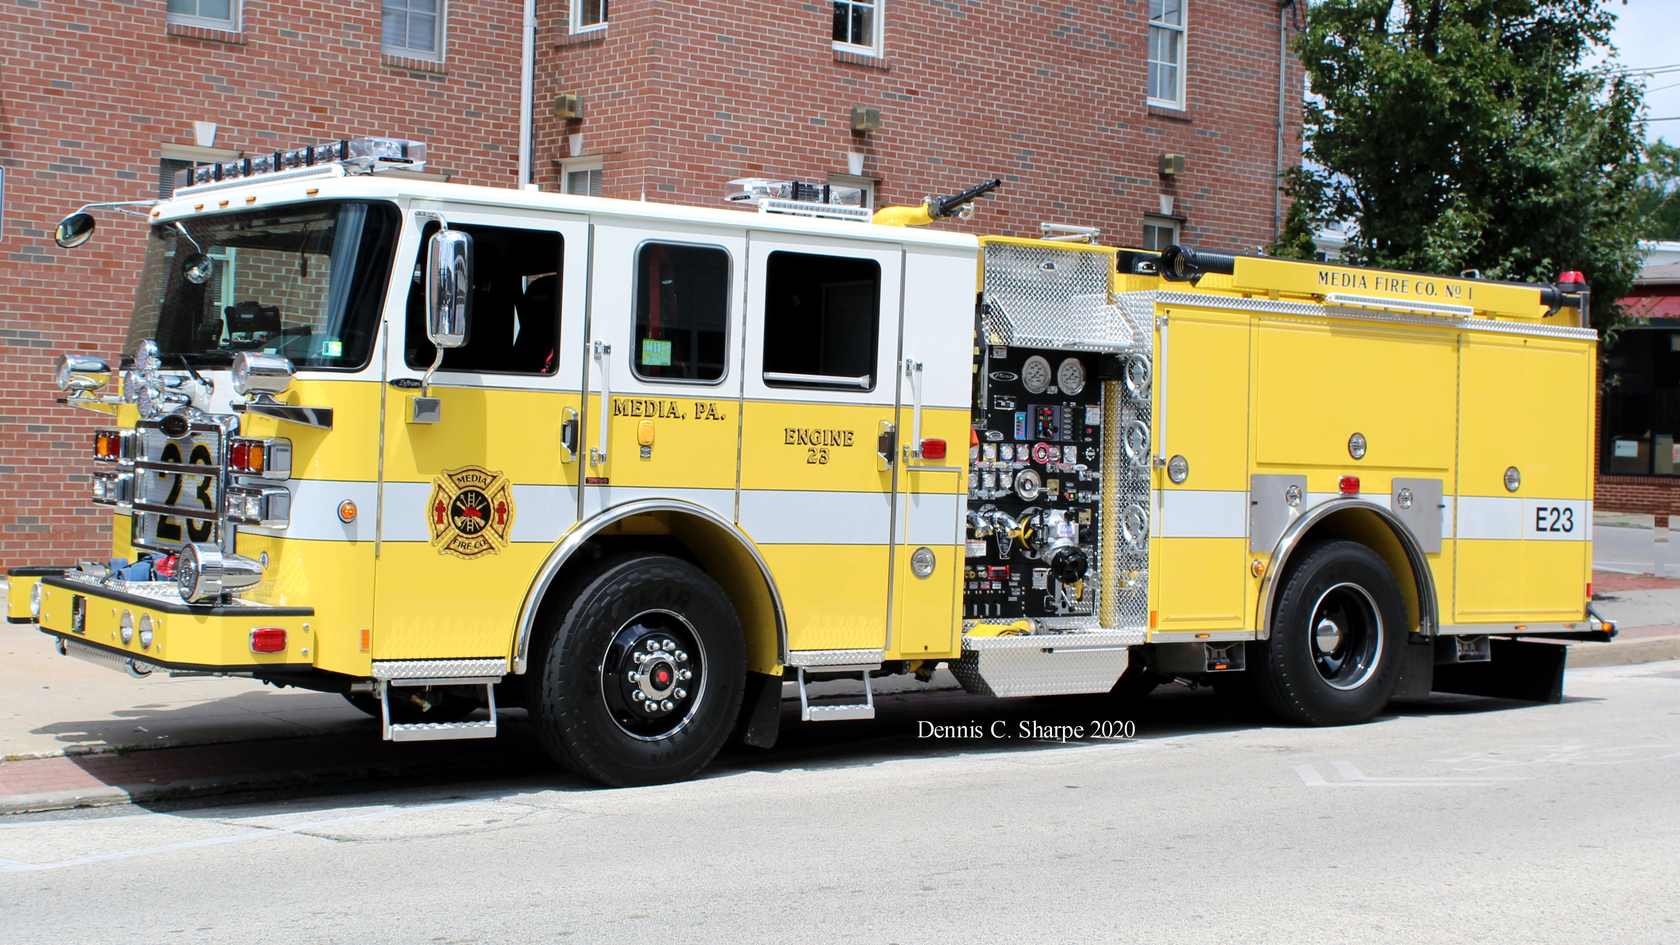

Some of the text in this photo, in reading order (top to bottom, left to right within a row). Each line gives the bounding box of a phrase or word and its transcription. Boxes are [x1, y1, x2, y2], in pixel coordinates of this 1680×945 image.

[1317, 270, 1368, 289] MEDIA
[1374, 276, 1410, 294] FIRE
[1415, 281, 1438, 296] CO.
[694, 402, 727, 421] PA.
[784, 428, 855, 447] ENGINE
[806, 447, 831, 465] 23
[456, 474, 488, 486] MEDIA
[156, 440, 214, 544] 23
[1535, 507, 1574, 533] E23
[452, 538, 472, 550] FIRE
